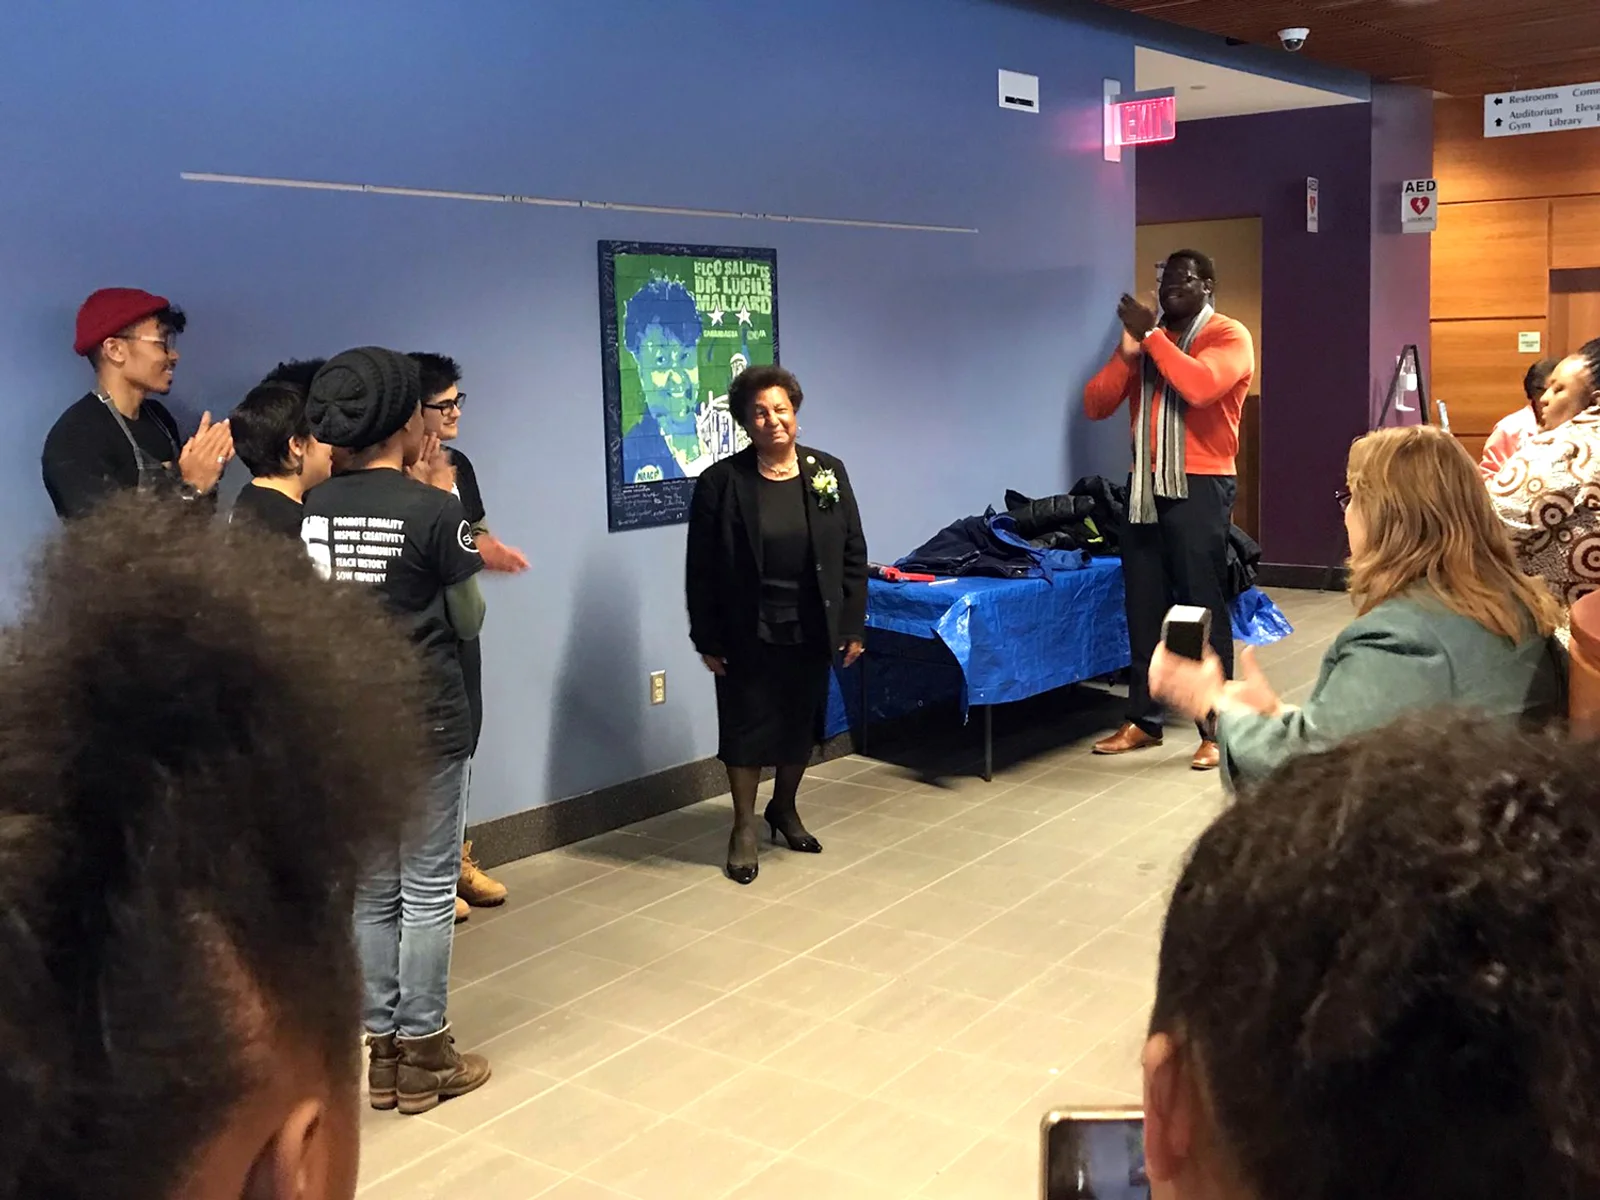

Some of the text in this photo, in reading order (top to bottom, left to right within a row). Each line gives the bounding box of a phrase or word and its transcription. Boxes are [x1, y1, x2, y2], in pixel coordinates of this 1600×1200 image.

[1509, 92, 1559, 104] Restrooms
[1509, 107, 1563, 119] Auditorium
[1122, 101, 1166, 141] EXIT
[1508, 117, 1583, 131] Gym Library
[1405, 180, 1436, 193] AED
[333, 517, 404, 530] PROMOTE EQUALITY
[333, 530, 405, 543] INSPIRE CREATIVITY
[335, 544, 402, 557] BUILD COMMUNITY
[335, 557, 387, 569] TEACH HISTORY
